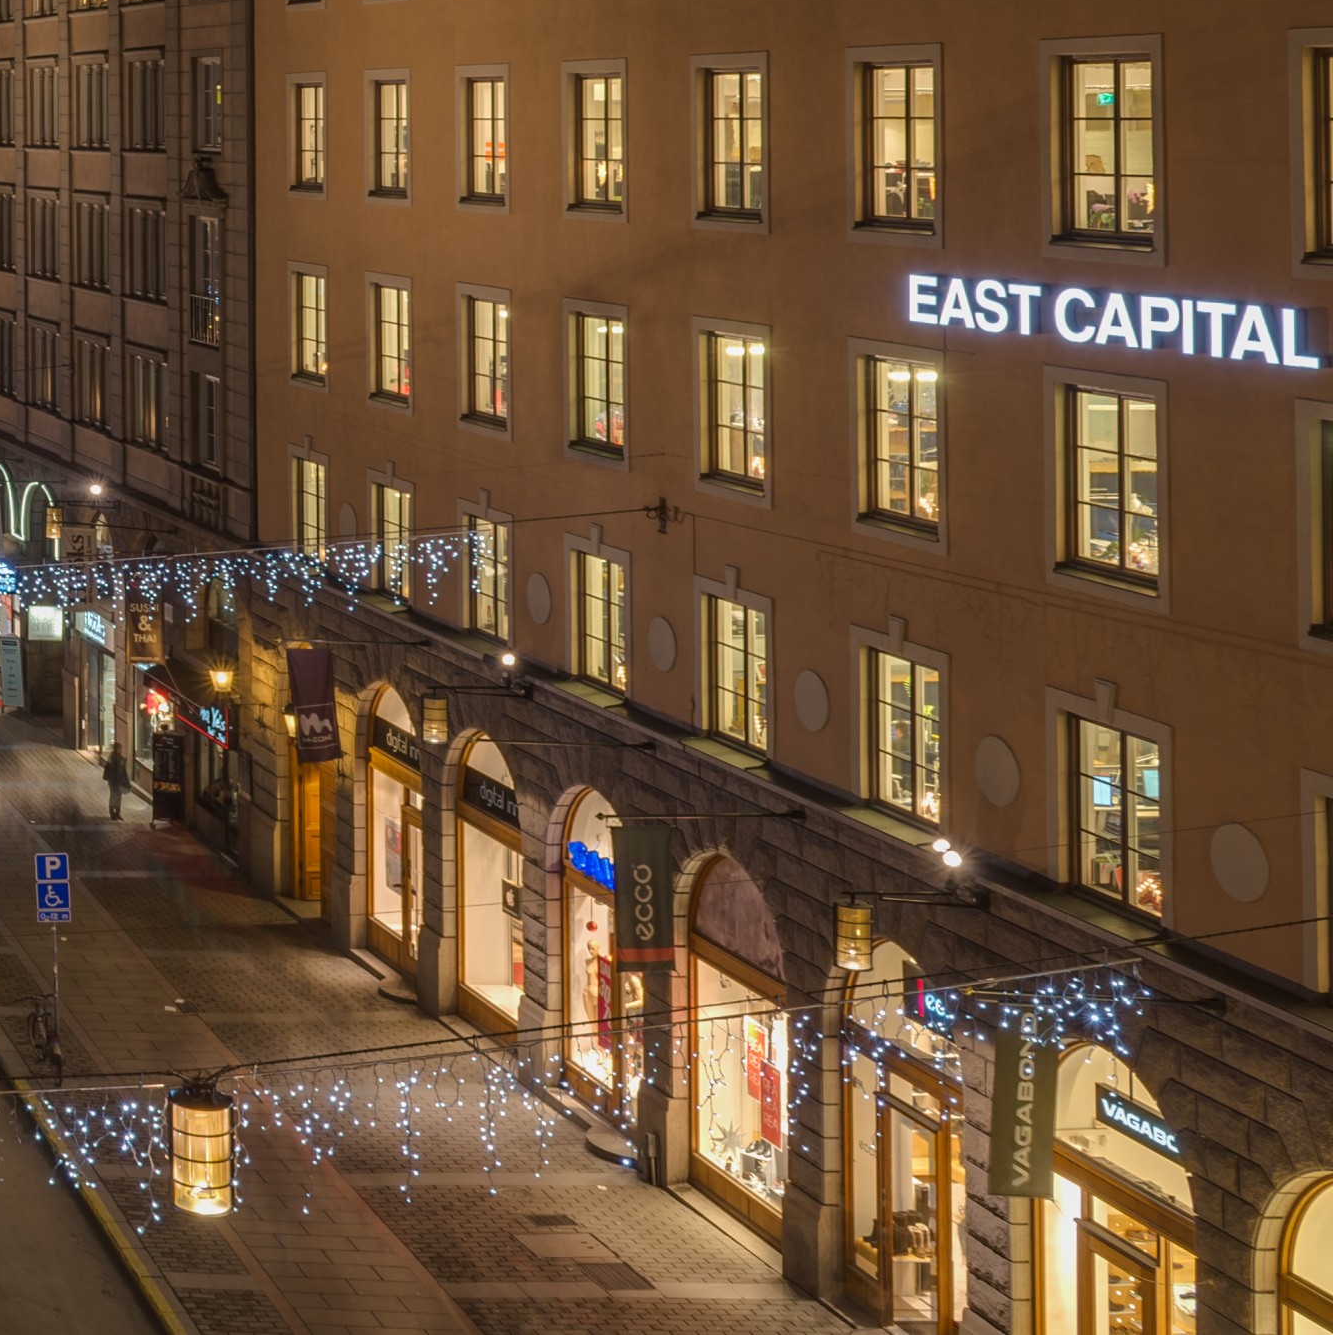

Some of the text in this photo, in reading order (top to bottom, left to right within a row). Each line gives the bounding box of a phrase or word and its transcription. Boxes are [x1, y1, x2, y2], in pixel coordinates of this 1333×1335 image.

[908, 274, 1321, 370] EAST CAPITAL
[138, 615, 153, 631] &
[132, 633, 158, 643] THAI
[386, 728, 408, 755] digital
[479, 779, 505, 810] digital
[44, 856, 61, 879] P
[633, 864, 655, 941] ecco
[1012, 1012, 1038, 1187] VAGABOND
